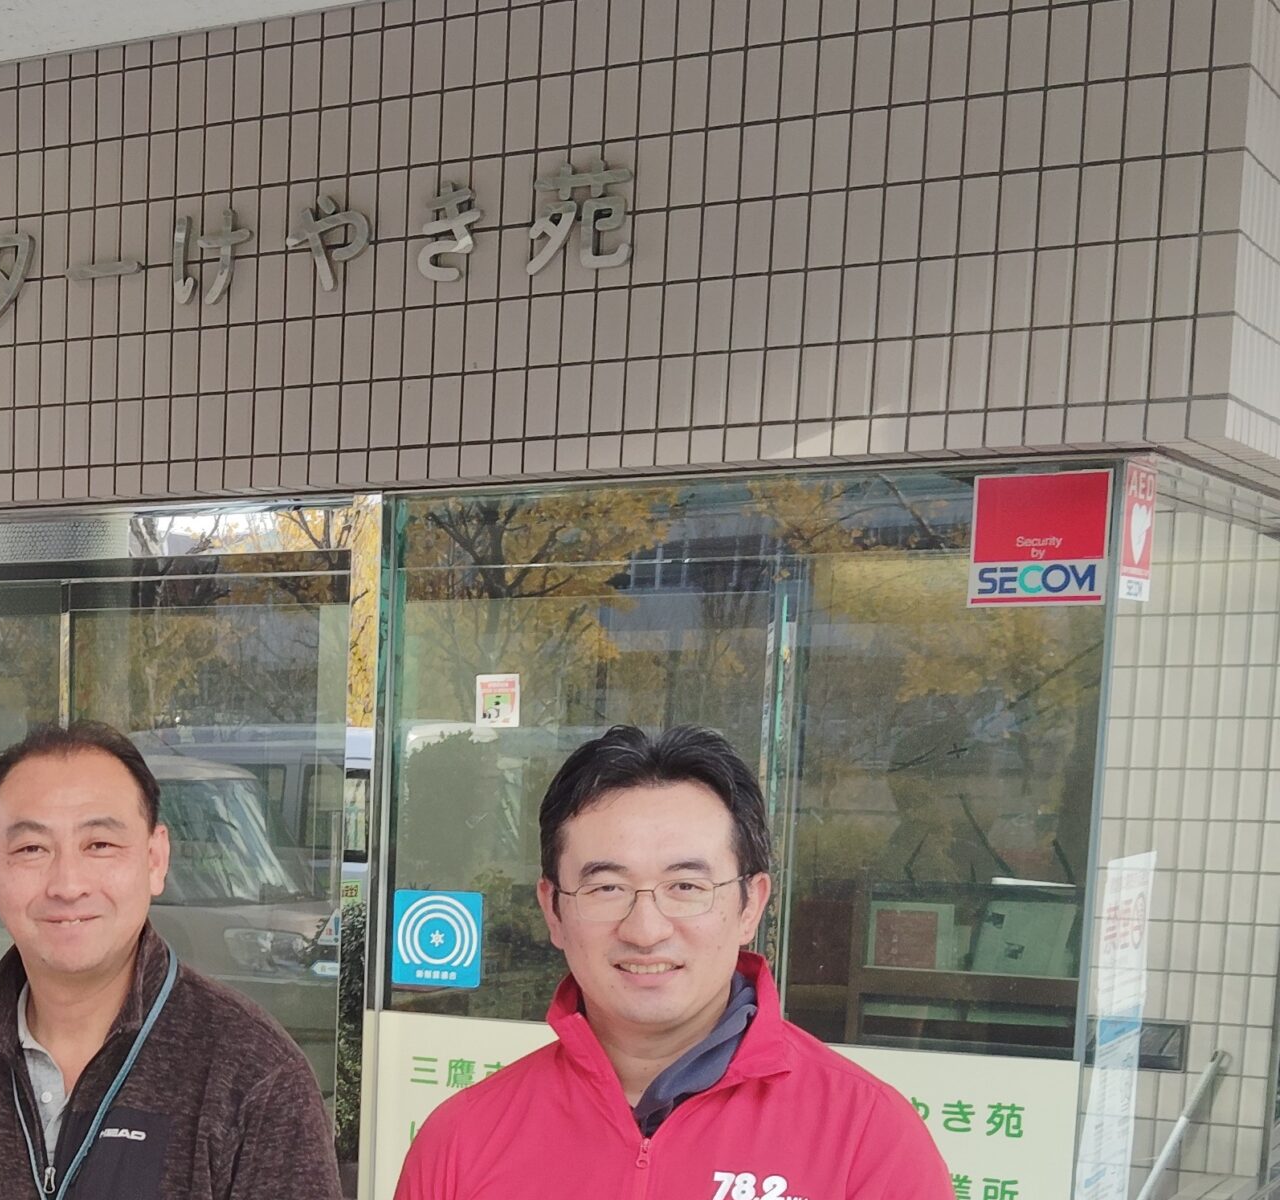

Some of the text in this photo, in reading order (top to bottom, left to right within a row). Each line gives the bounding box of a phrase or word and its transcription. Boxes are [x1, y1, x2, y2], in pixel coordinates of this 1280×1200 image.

[1128, 470, 1155, 501] AED
[1016, 536, 1062, 549] Security
[1030, 547, 1045, 560] by
[977, 564, 1096, 595] SECOM
[99, 1128, 147, 1141] HEAD
